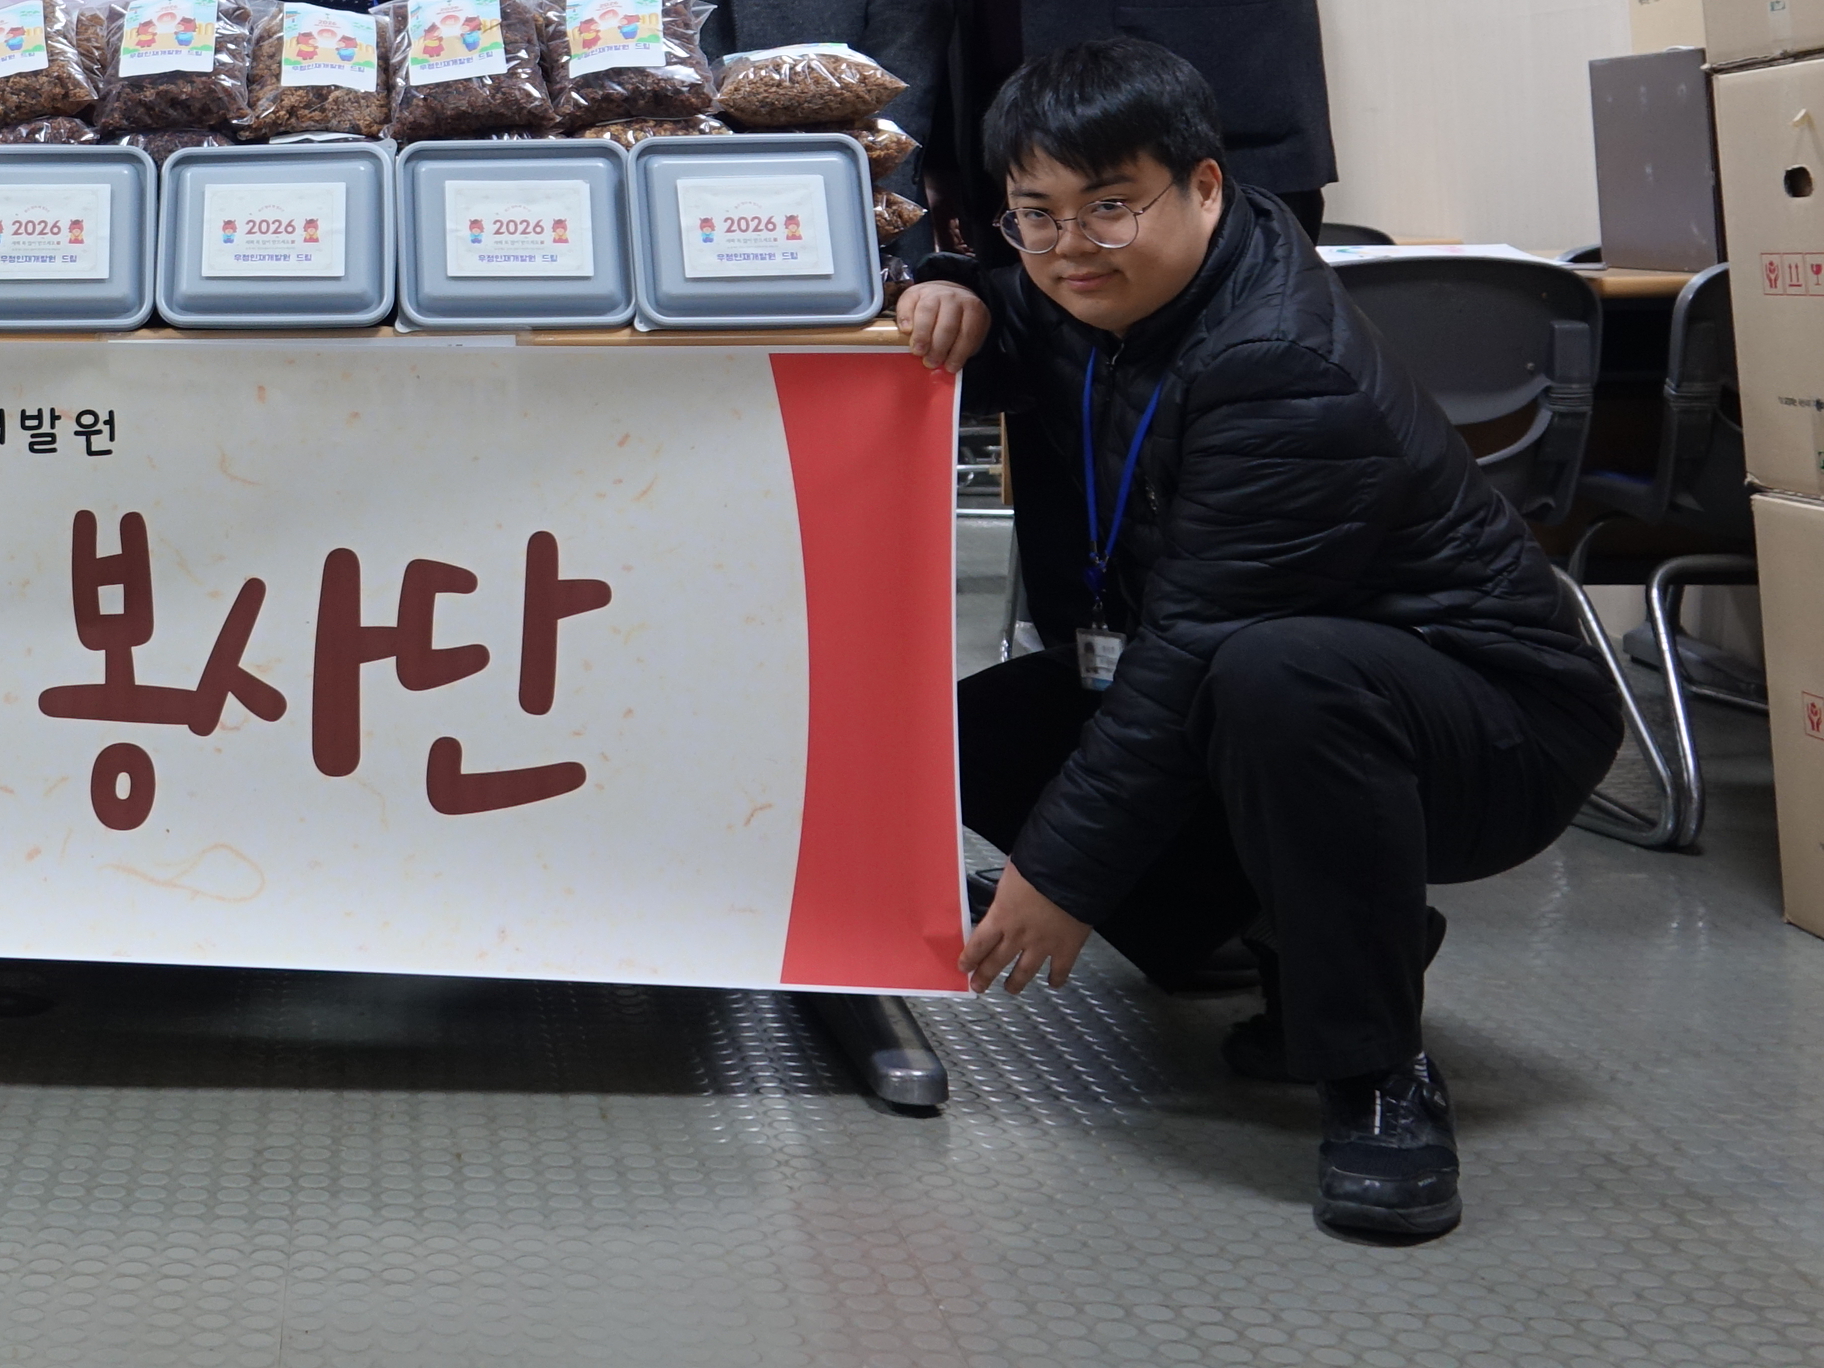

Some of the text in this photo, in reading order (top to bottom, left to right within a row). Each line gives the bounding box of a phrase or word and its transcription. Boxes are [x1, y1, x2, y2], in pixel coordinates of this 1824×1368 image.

[11, 219, 62, 236] 2026
[245, 219, 297, 235] 2026
[492, 219, 545, 235] 2026
[723, 215, 777, 233] 2026
[0, 255, 78, 263] 우정인재개발원 드림
[233, 253, 312, 262] 우정인재개발원 드림
[478, 254, 558, 263] 우정인재개발원 드림
[716, 251, 799, 261] 우정인재개발원 드림
[39, 510, 611, 830] 봉사단
